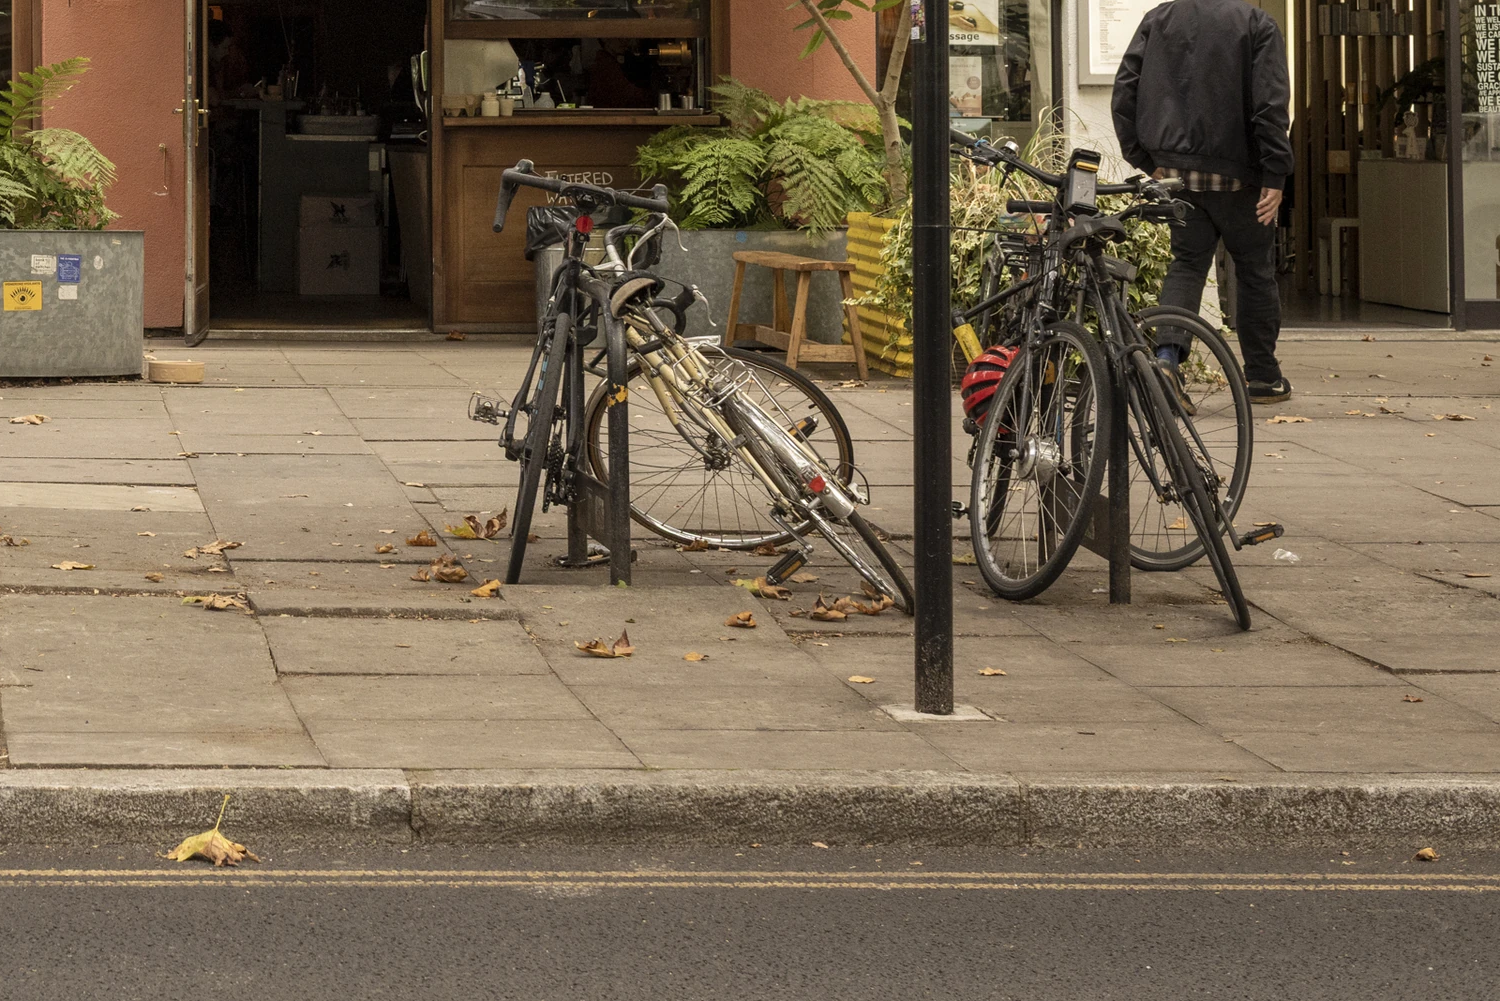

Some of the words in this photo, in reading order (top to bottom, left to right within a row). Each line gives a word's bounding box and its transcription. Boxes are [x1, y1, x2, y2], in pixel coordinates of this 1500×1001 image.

[1474, 4, 1487, 17] IN
[949, 33, 979, 42] ssage
[1476, 39, 1495, 51] WE
[1476, 51, 1496, 63] WE
[1477, 72, 1495, 82] WE
[1478, 96, 1495, 106] WE
